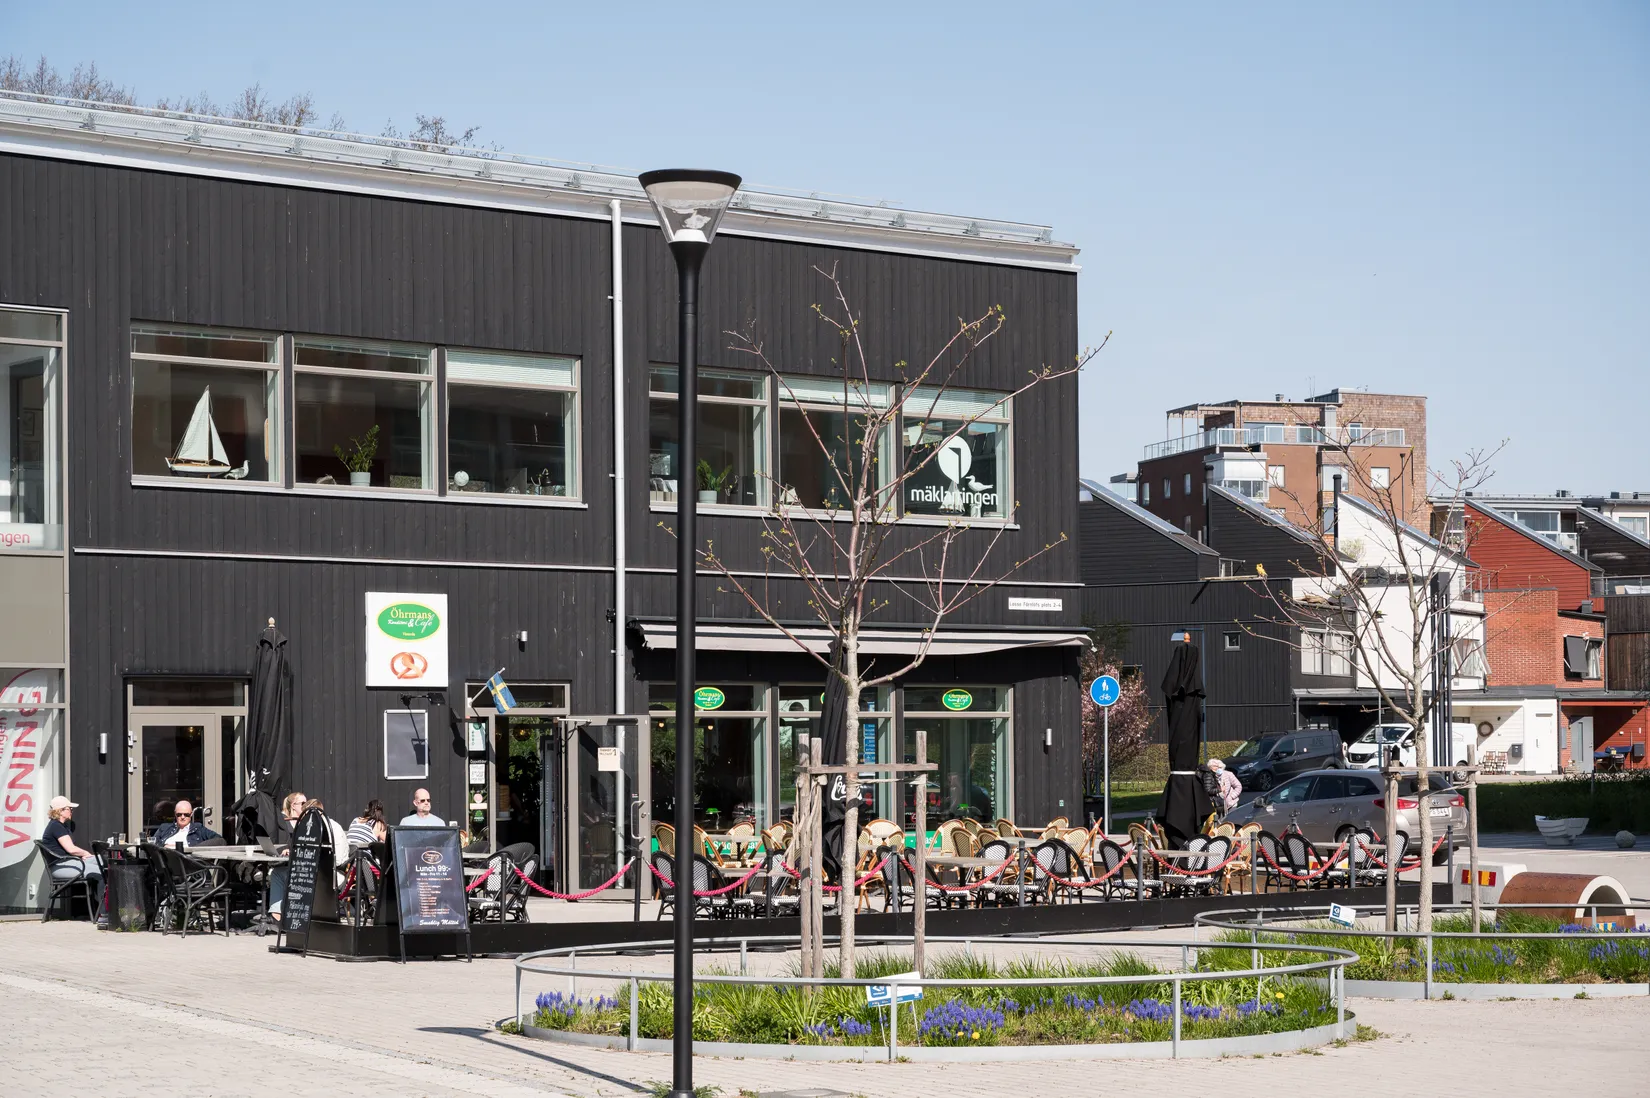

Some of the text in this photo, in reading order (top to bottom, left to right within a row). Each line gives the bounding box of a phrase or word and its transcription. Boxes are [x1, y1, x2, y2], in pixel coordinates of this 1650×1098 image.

[390, 607, 432, 619] Öhrmans
[407, 618, 415, 628] &
[414, 613, 436, 634] Café
[3, 691, 42, 849] VISNING
[415, 864, 437, 872] Lunch
